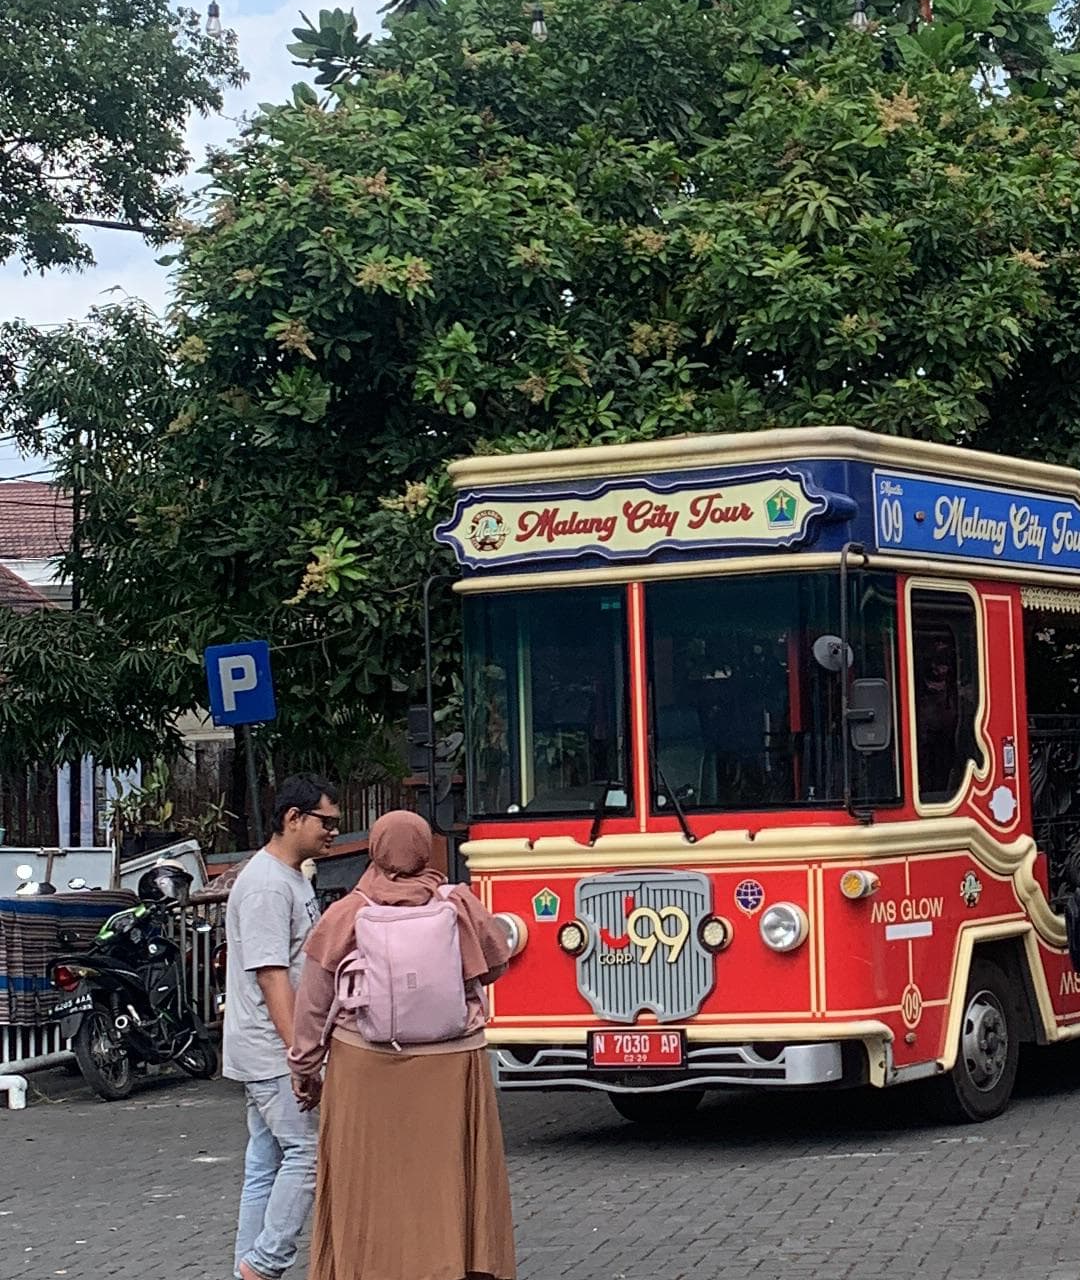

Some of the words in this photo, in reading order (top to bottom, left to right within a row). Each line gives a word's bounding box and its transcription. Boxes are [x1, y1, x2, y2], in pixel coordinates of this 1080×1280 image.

[515, 508, 618, 543] Malang
[622, 500, 680, 537] City
[688, 492, 754, 529] Tour
[881, 498, 903, 543] 09
[933, 495, 1007, 555] Malang
[1009, 503, 1047, 560] City
[218, 654, 258, 712] P
[901, 896, 944, 921] GLOW
[905, 992, 919, 1020] 09
[596, 1035, 606, 1054] N
[614, 1035, 650, 1054] 7030
[661, 1035, 679, 1054] AP
